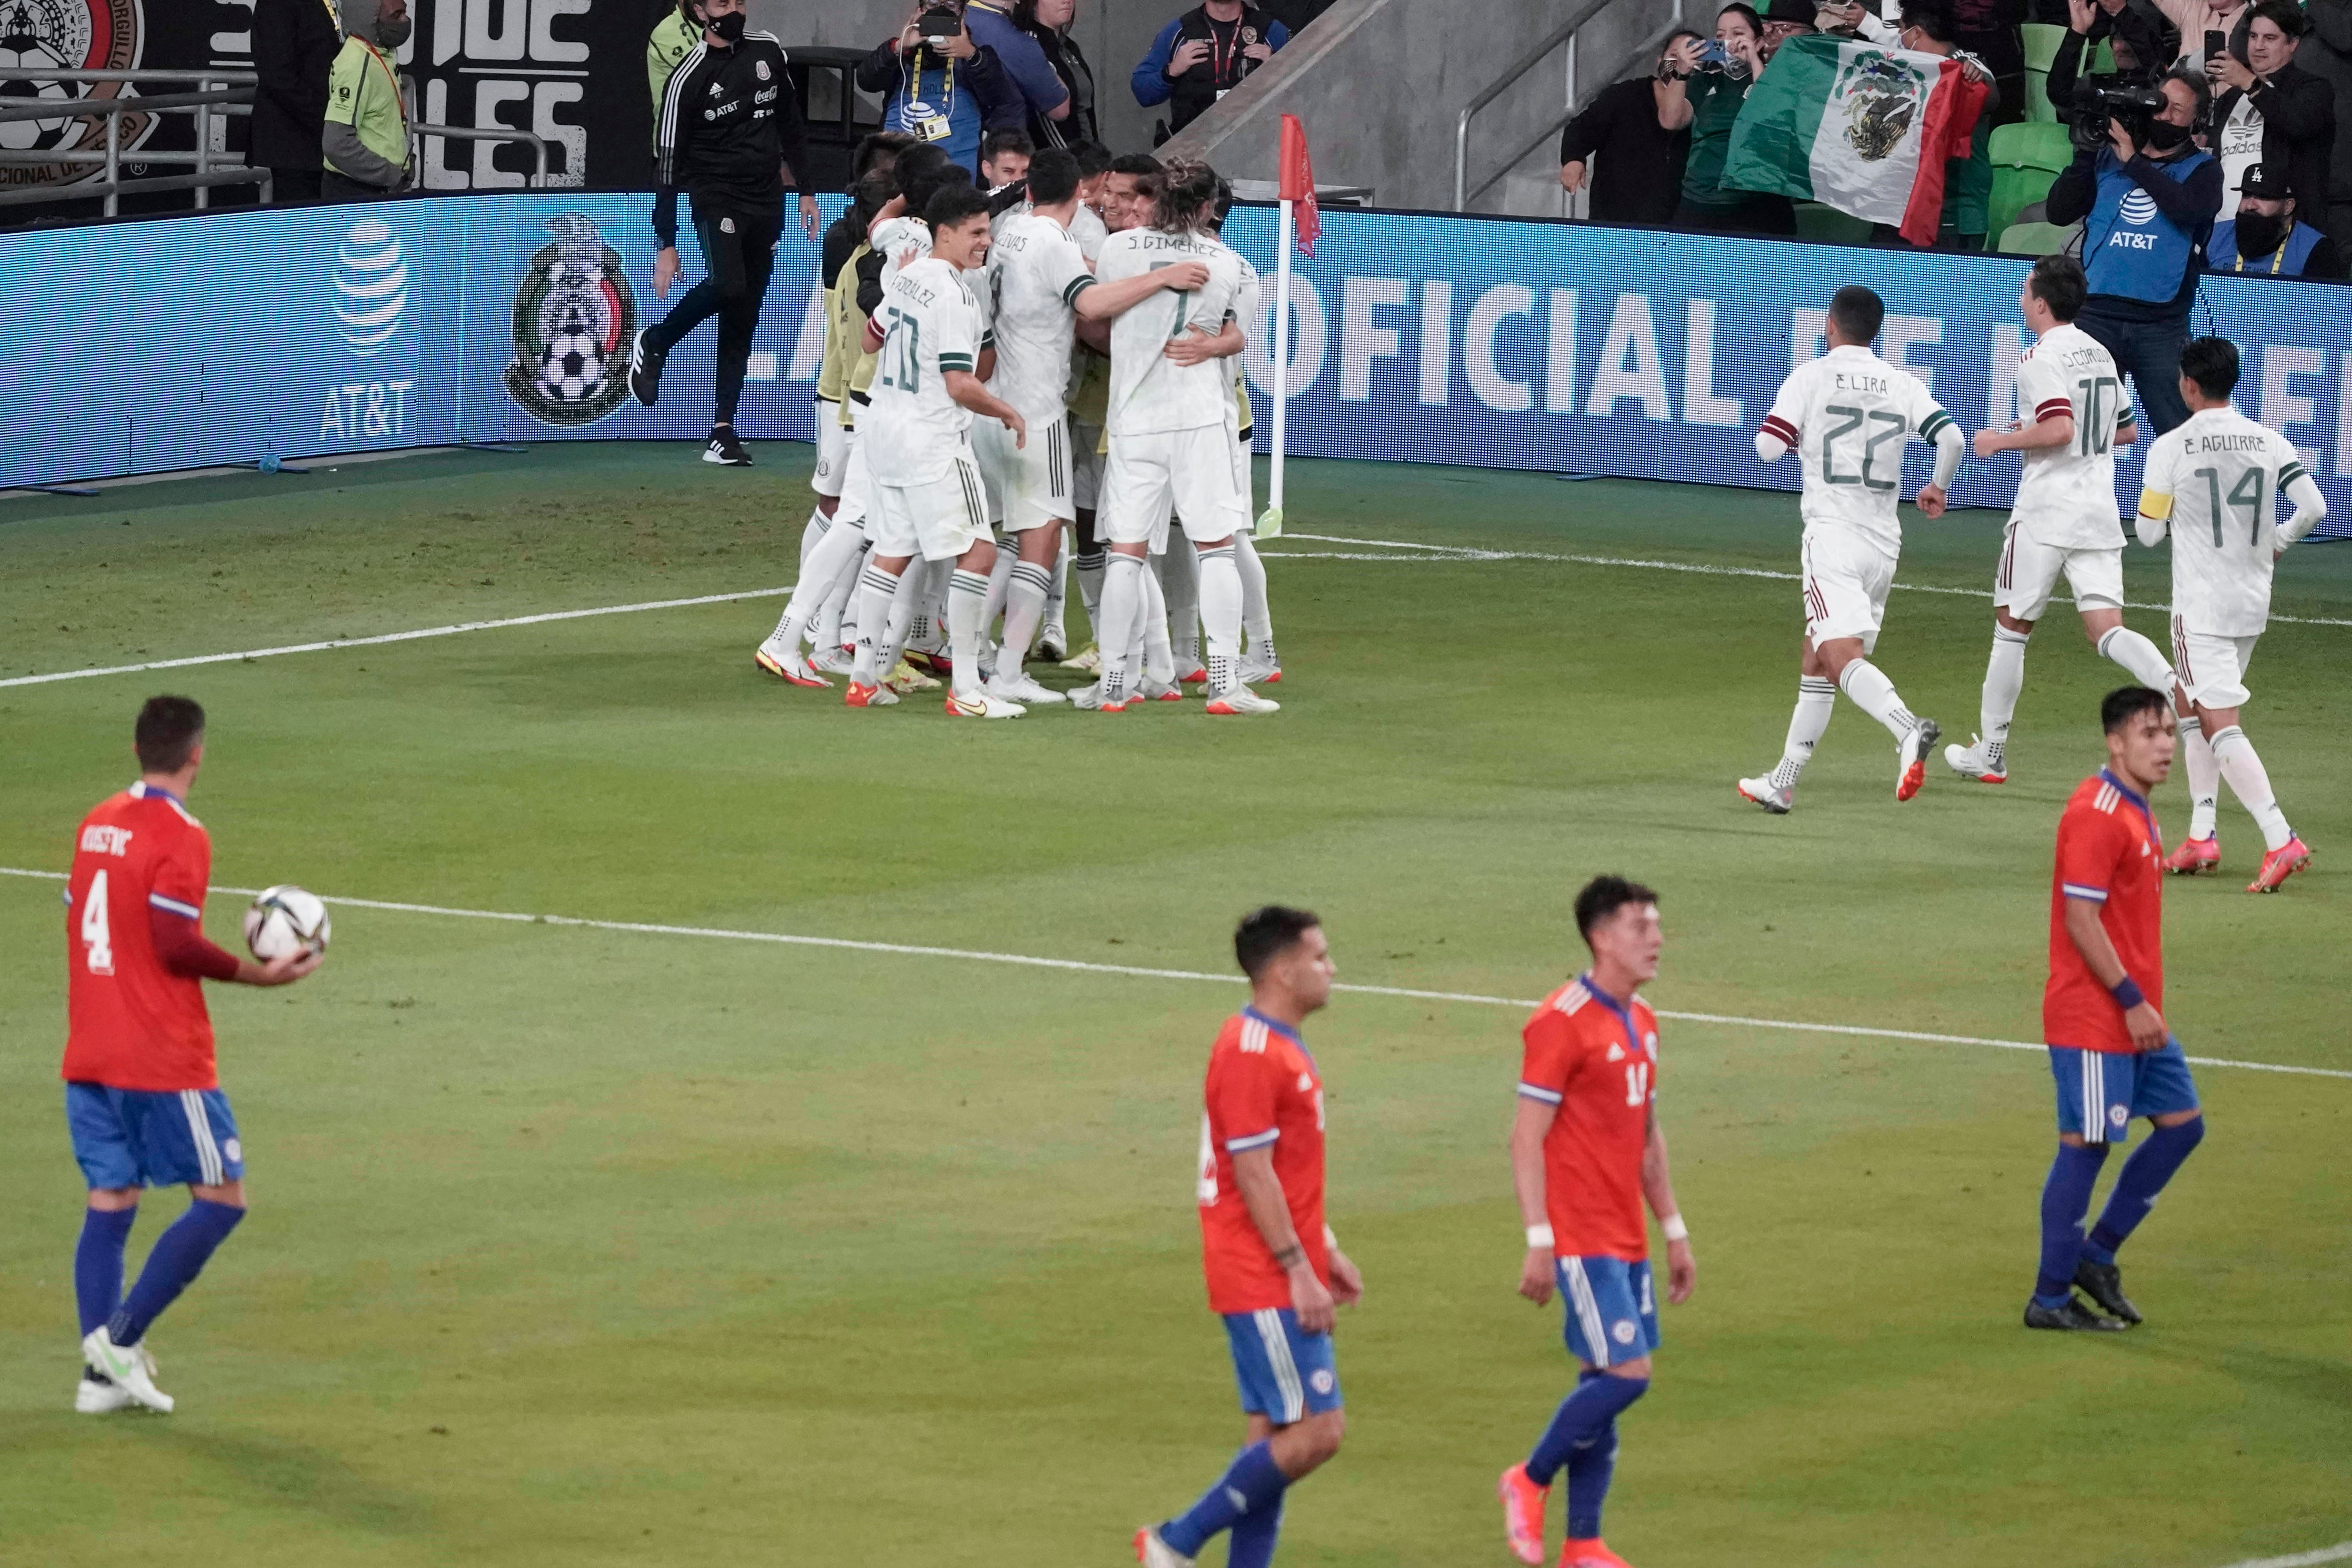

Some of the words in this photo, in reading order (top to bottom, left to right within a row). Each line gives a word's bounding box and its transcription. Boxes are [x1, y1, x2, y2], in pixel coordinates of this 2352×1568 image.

[717, 100, 739, 117] AT&T
[2222, 141, 2262, 156] adidas
[2251, 167, 2263, 182] LA
[2109, 231, 2158, 250] AT&T
[883, 306, 920, 394] 20
[1241, 271, 1743, 428] OFICIAL
[319, 382, 414, 440] AT&T
[1823, 405, 1907, 490] 22
[2079, 377, 2117, 458] 10
[2194, 467, 2264, 548] 14
[82, 868, 115, 977] 4
